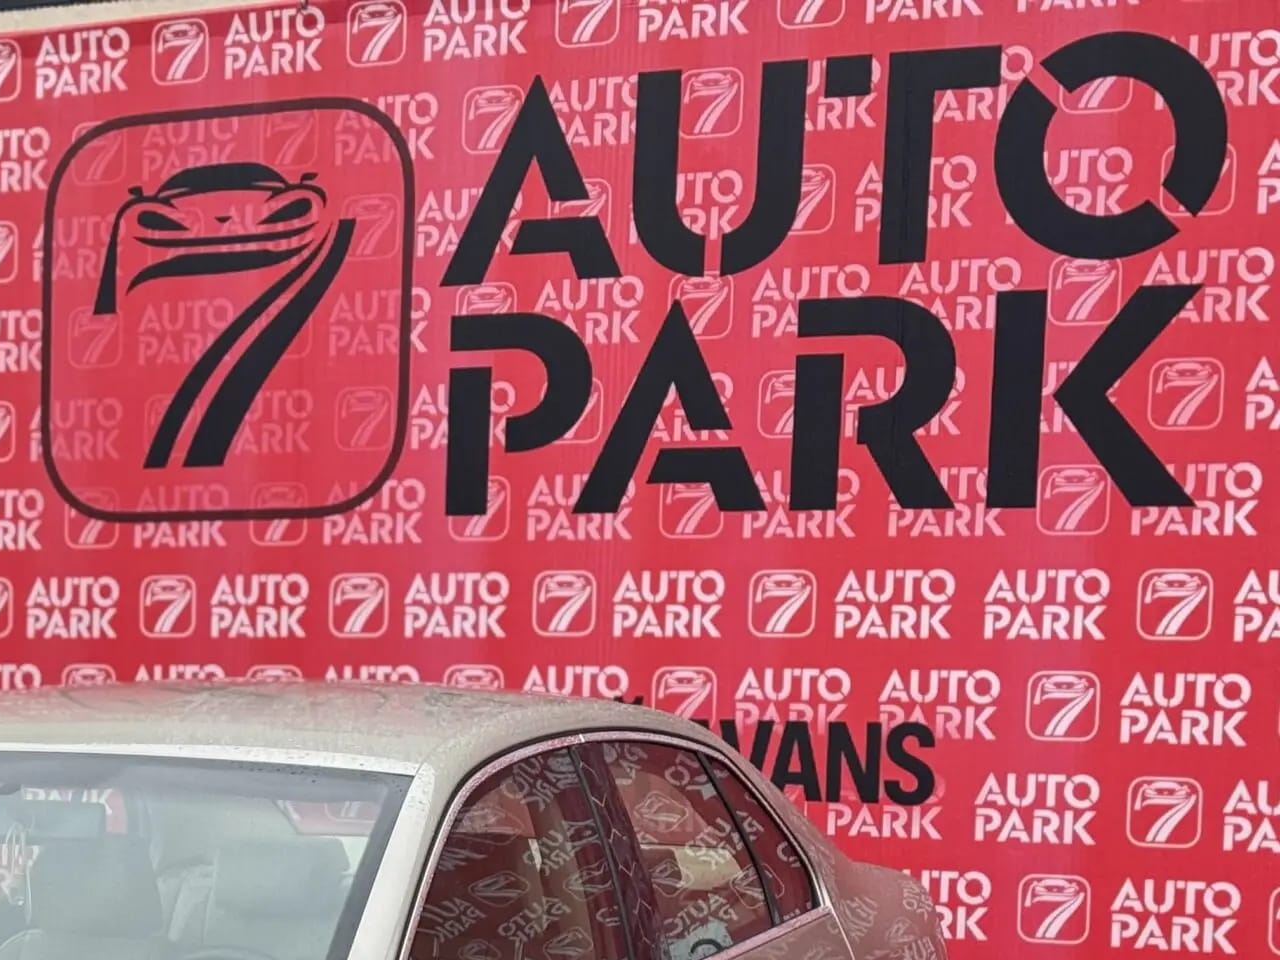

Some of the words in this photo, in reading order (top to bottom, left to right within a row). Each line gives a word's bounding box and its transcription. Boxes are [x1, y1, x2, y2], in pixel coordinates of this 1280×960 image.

[224, 6, 324, 45] AUTO
[638, 1, 749, 43] PARK
[35, 27, 129, 66] AUTO
[225, 39, 321, 79] PARK
[424, 23, 526, 61] PARK
[36, 59, 127, 99] PARK
[440, 31, 1228, 286] AUTO
[752, 265, 871, 302] AUTO
[899, 258, 1022, 297] AUTO
[1144, 248, 1275, 286] AUTO
[535, 275, 645, 313] AUTO
[138, 300, 234, 332] AUTO
[563, 311, 641, 347] ARK
[446, 284, 1204, 515] PARK
[235, 421, 310, 454] ARK
[1167, 462, 1263, 500] UTO
[134, 521, 226, 548] PARK
[324, 512, 423, 546] PARK
[528, 508, 633, 541] PARK
[743, 505, 857, 540] PARK
[888, 503, 1007, 538] PARK
[1131, 500, 1259, 537] PARK
[27, 577, 119, 608] AUTO
[211, 574, 309, 605] AUTO
[405, 572, 509, 604] AUTO
[613, 570, 725, 603] AUTO
[835, 569, 955, 603] AUTO
[985, 569, 1109, 603] AUTO
[27, 608, 116, 638] PARK
[211, 606, 305, 637] PARK
[405, 605, 505, 637] PARK
[613, 604, 721, 637] PARK
[835, 605, 951, 638] PARK
[984, 605, 1105, 639] PARK
[523, 665, 629, 699] AUTO
[734, 668, 852, 703] AUTO
[879, 668, 1002, 706] AUTO
[1120, 673, 1251, 709] AUTO
[1120, 709, 1246, 746] PARK
[694, 720, 937, 806] VANS
[975, 773, 1099, 808] AUTO
[827, 803, 942, 841] PARK
[975, 808, 1095, 844] PARK
[1111, 879, 1241, 917] AUTO
[1111, 913, 1236, 954] PARK
